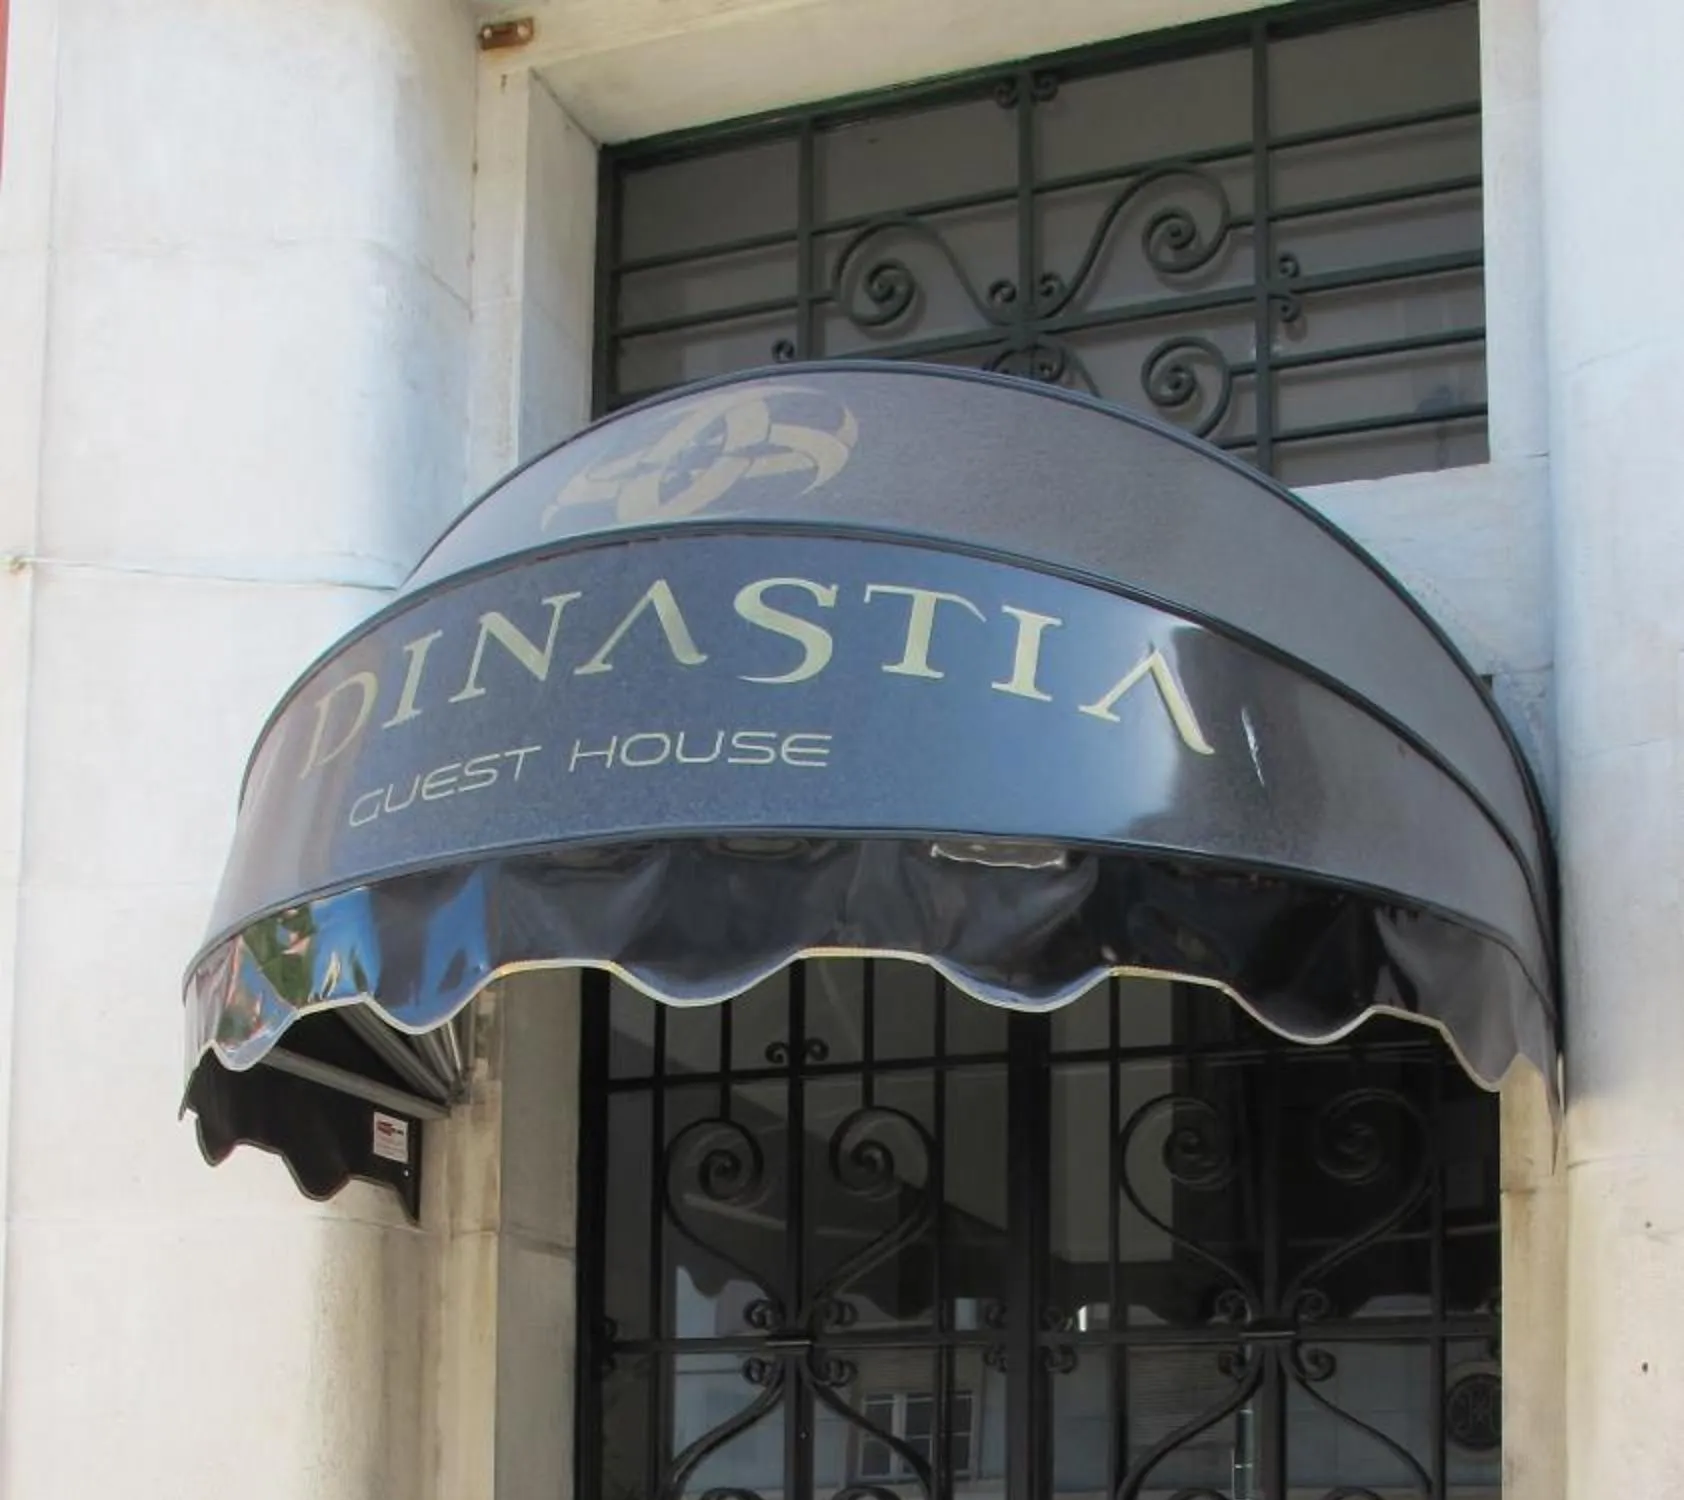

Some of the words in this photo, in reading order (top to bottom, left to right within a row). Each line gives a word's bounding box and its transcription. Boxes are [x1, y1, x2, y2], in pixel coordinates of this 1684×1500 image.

[300, 576, 1215, 781] DINASTIA
[349, 745, 542, 828] GUEST
[568, 729, 833, 773] HOUSE
